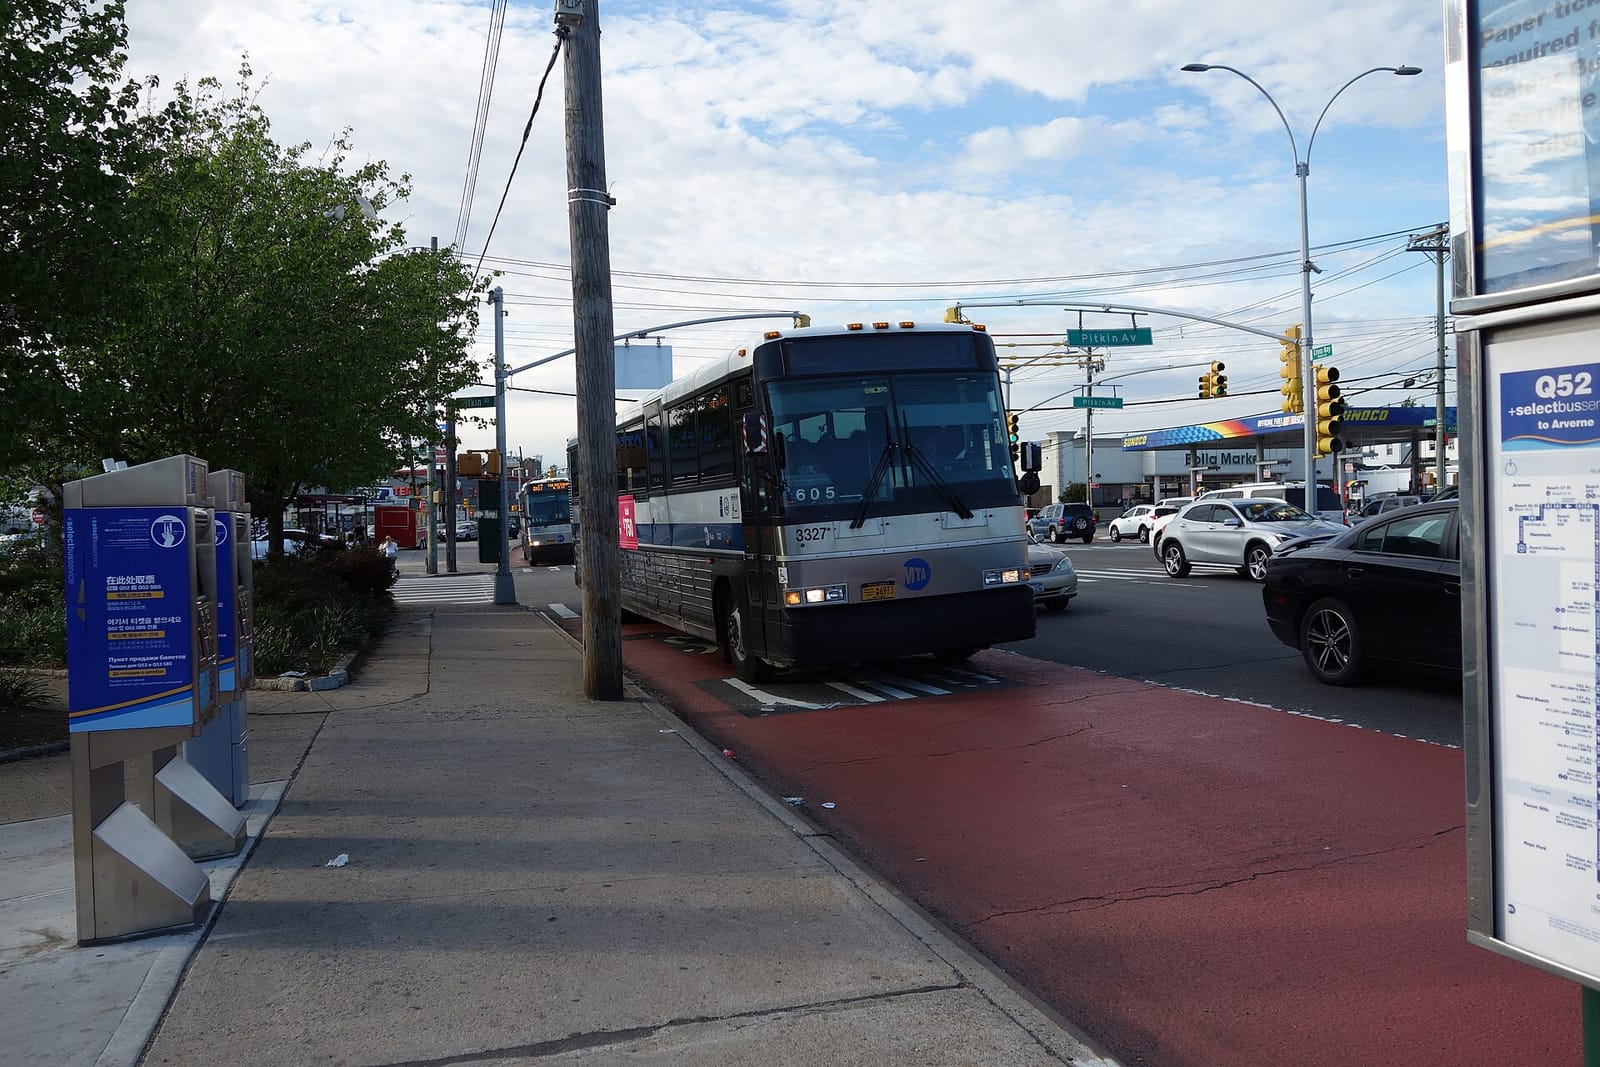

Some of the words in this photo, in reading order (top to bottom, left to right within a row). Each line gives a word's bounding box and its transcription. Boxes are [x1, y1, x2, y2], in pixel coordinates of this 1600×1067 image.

[1480, 9, 1547, 48] Paper
[1082, 334, 1118, 342] Pitkin
[1122, 334, 1136, 342] Av
[1535, 372, 1592, 399] Q52
[1343, 410, 1388, 420] UNOCO
[1538, 420, 1549, 430] to
[1552, 418, 1594, 428] Arverne
[1124, 436, 1148, 448] SUNOCO
[1221, 453, 1257, 465] Marke
[796, 487, 835, 501] 605
[796, 528, 826, 541] 3327
[904, 566, 926, 584] MTA
